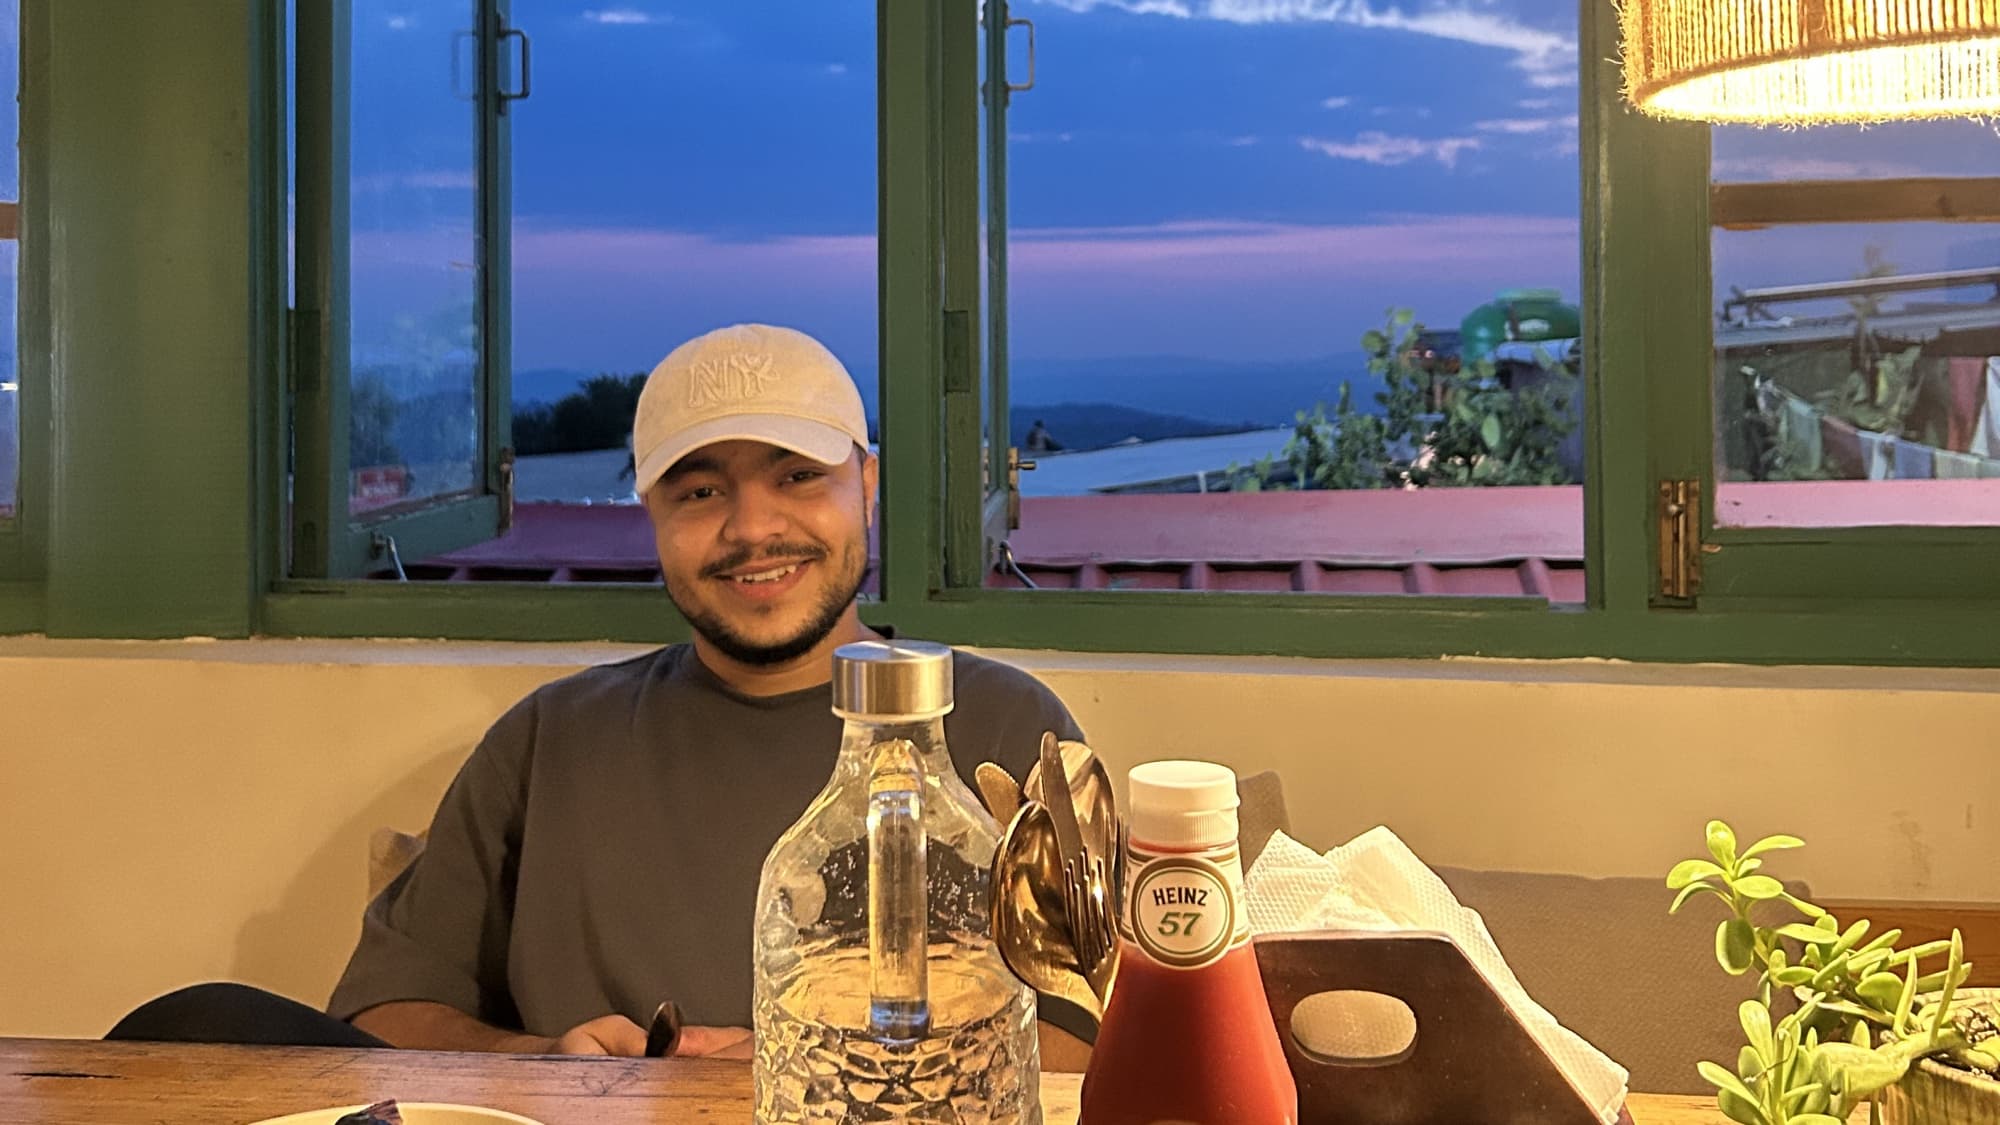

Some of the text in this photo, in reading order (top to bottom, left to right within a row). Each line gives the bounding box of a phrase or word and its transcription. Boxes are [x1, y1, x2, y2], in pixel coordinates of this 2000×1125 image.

[688, 353, 780, 408] NY
[1152, 887, 1208, 907] HEINZ
[1158, 911, 1203, 936] 57
